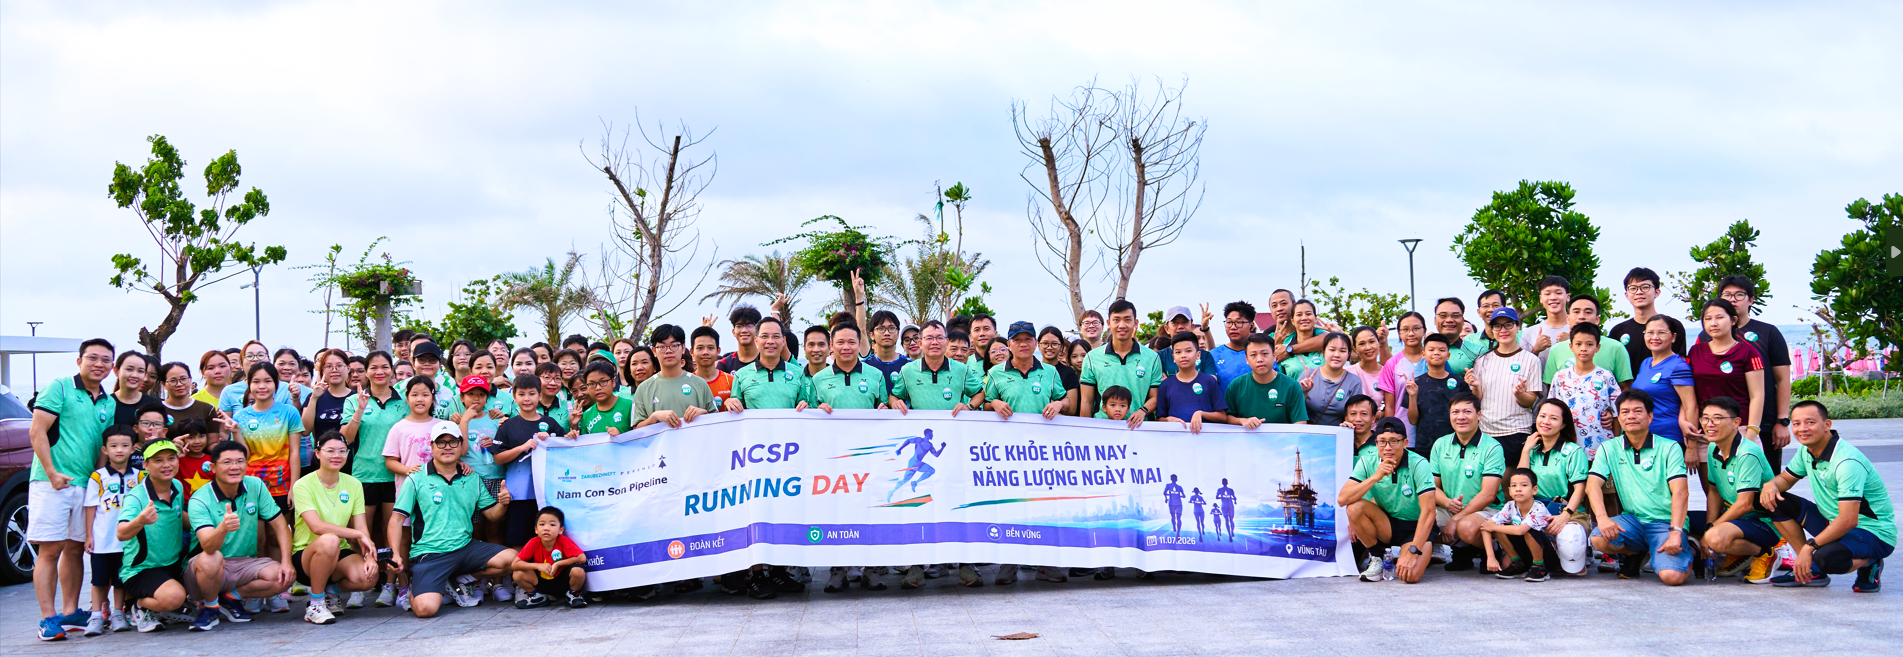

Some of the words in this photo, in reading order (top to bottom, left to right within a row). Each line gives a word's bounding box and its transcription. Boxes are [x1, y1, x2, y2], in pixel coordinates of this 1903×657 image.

[730, 442, 800, 470] NCSP
[969, 441, 1002, 462] SỨC
[1004, 440, 1049, 462] KHỎE
[1052, 441, 1091, 462] HÔM
[1094, 444, 1128, 462] NAY
[972, 466, 1020, 486] NĂNG
[1023, 468, 1078, 490] LƯỢNG
[1081, 465, 1126, 486] NGÀY
[1130, 467, 1162, 485] MAI
[556, 490, 581, 500] Nam
[584, 489, 604, 498] Con
[608, 487, 626, 496] Son
[629, 476, 668, 492] Pipeline
[684, 476, 802, 516] RUNNING
[812, 472, 870, 496] DAY
[827, 530, 838, 539] AN
[839, 529, 860, 539] TOÀN
[1159, 536, 1196, 545] 11.07.2026
[690, 540, 711, 551] ĐOÀN
[712, 536, 725, 548] KẾT
[1297, 545, 1314, 556] VŨNG
[1315, 546, 1328, 556] TÀU
[587, 555, 605, 567] KHỎE
